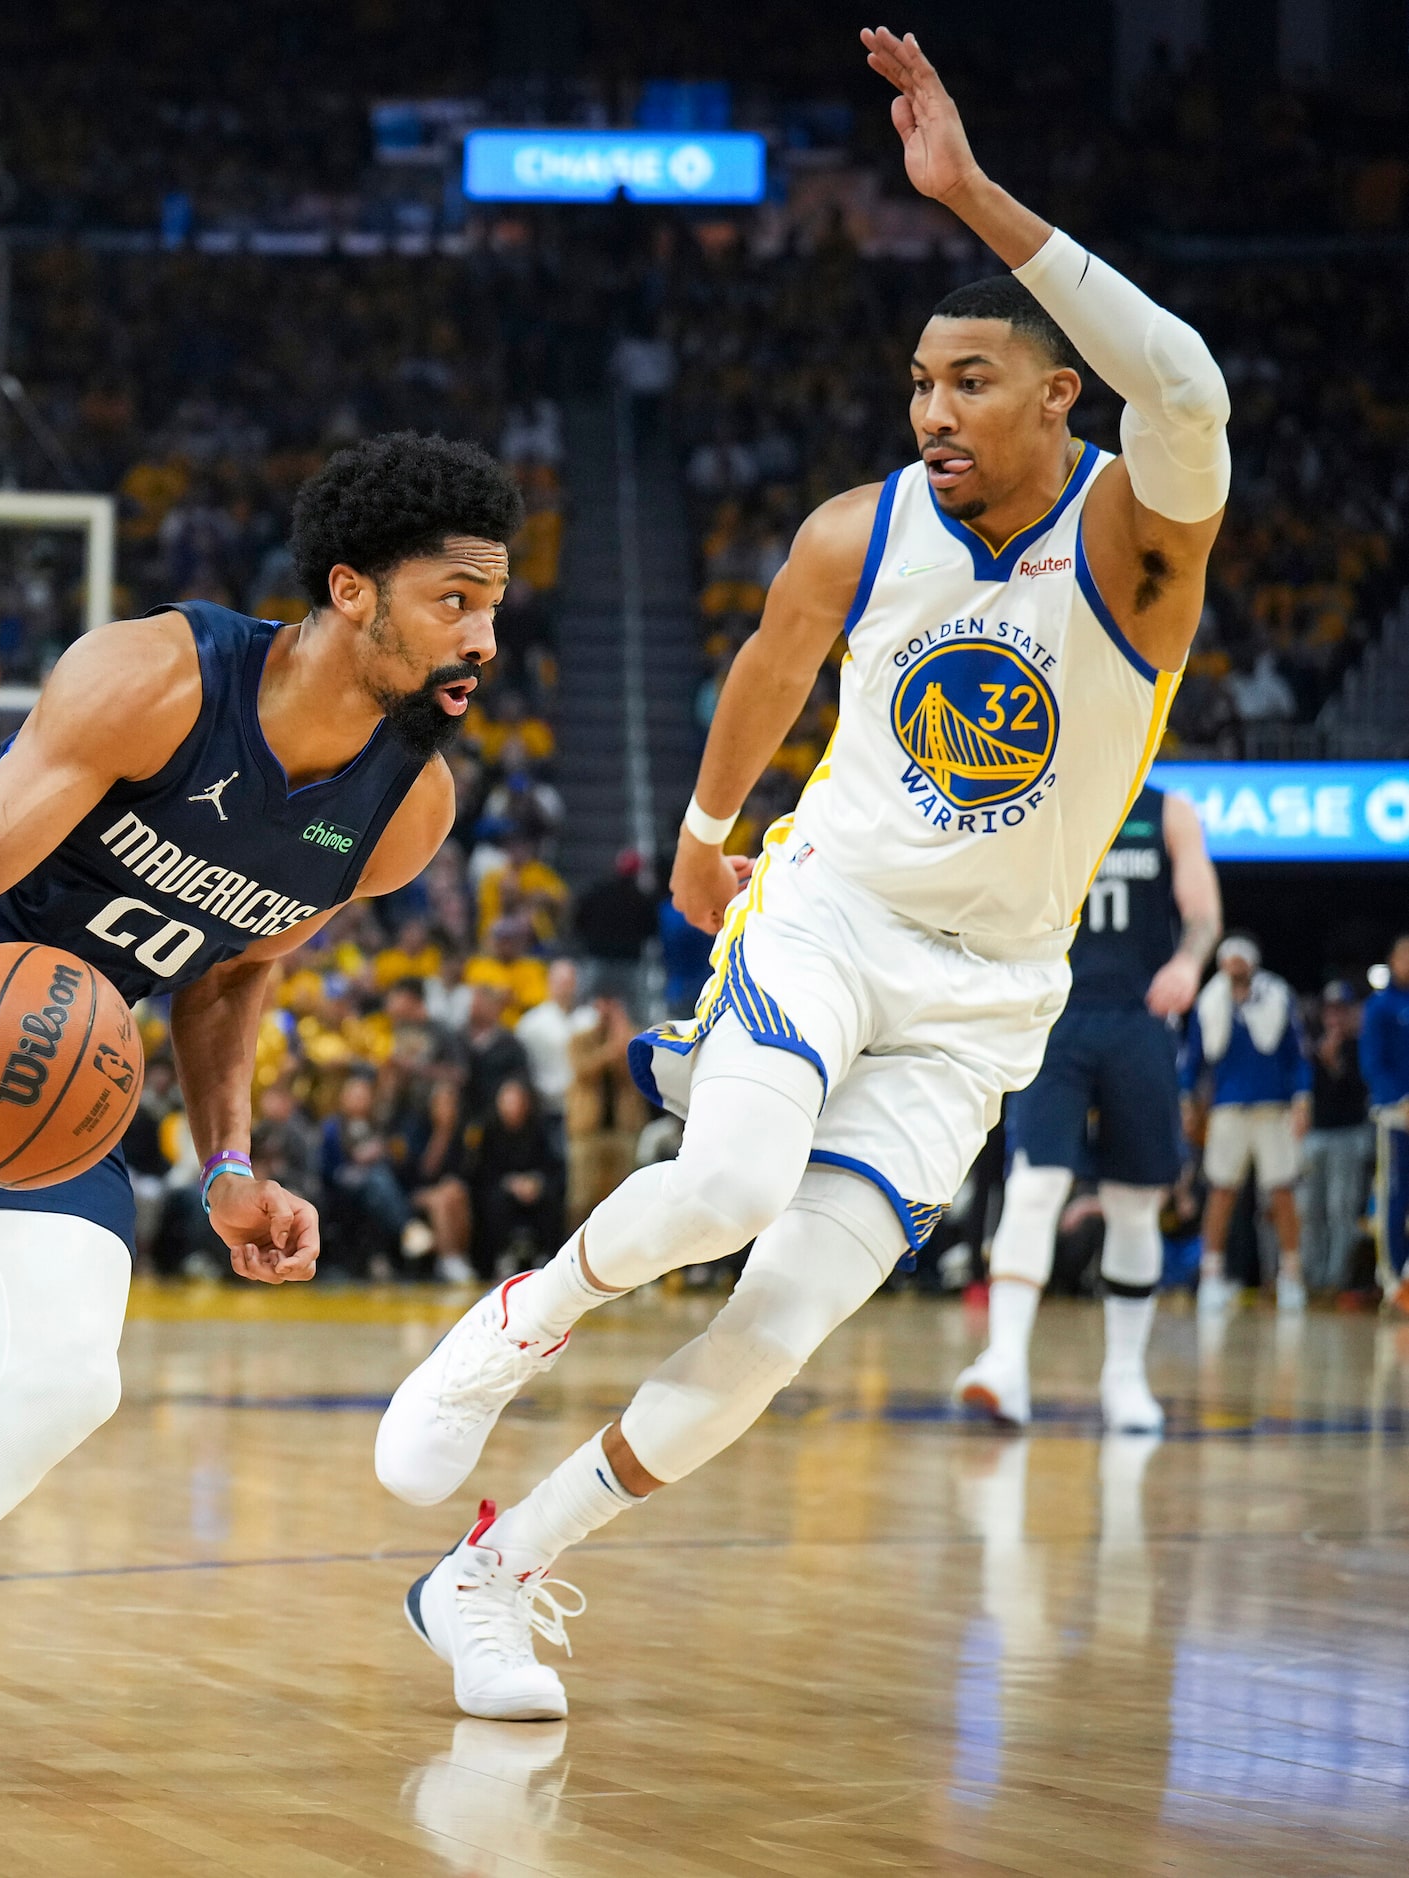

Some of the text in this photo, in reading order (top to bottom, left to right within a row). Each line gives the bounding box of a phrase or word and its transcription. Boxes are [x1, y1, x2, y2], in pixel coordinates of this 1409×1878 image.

[893, 616, 1058, 673] GOLDEN STATE
[977, 682, 1039, 732] 32
[301, 821, 354, 854] chime
[99, 811, 319, 937] MAVERICKS
